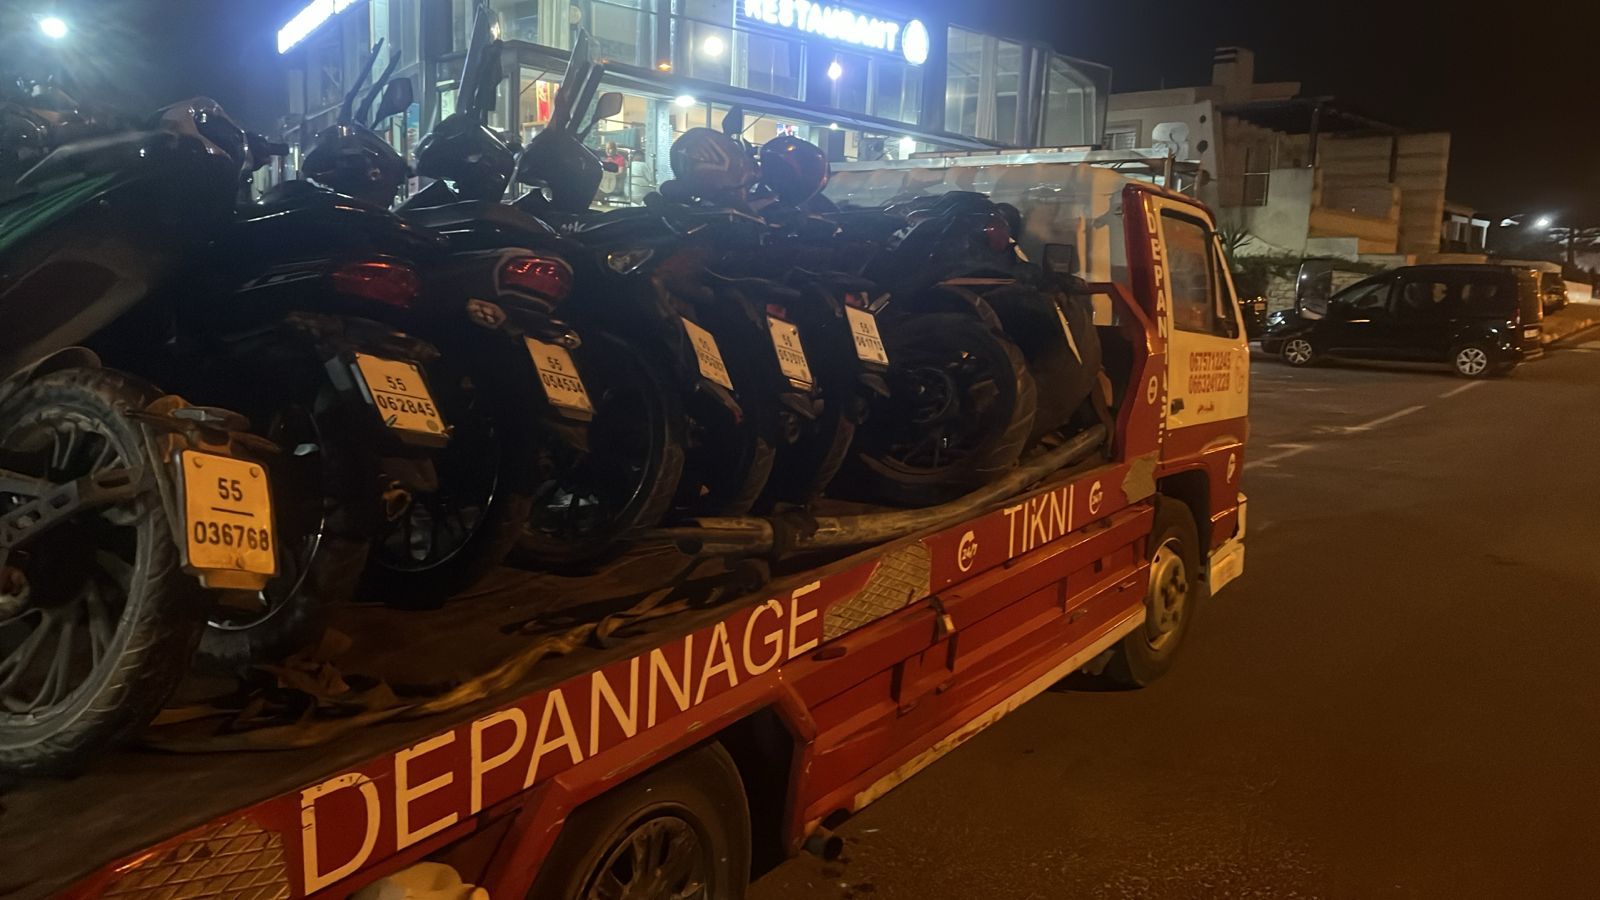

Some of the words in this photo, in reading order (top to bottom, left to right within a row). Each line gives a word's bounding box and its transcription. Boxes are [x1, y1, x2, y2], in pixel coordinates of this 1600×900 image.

[546, 356, 562, 371] 55
[386, 375, 407, 391] 55
[376, 394, 436, 417] 062845
[218, 477, 243, 501] 55
[1003, 484, 1074, 559] TIKNI
[194, 521, 270, 551] 036768
[300, 580, 822, 897] DEPANNAGE
